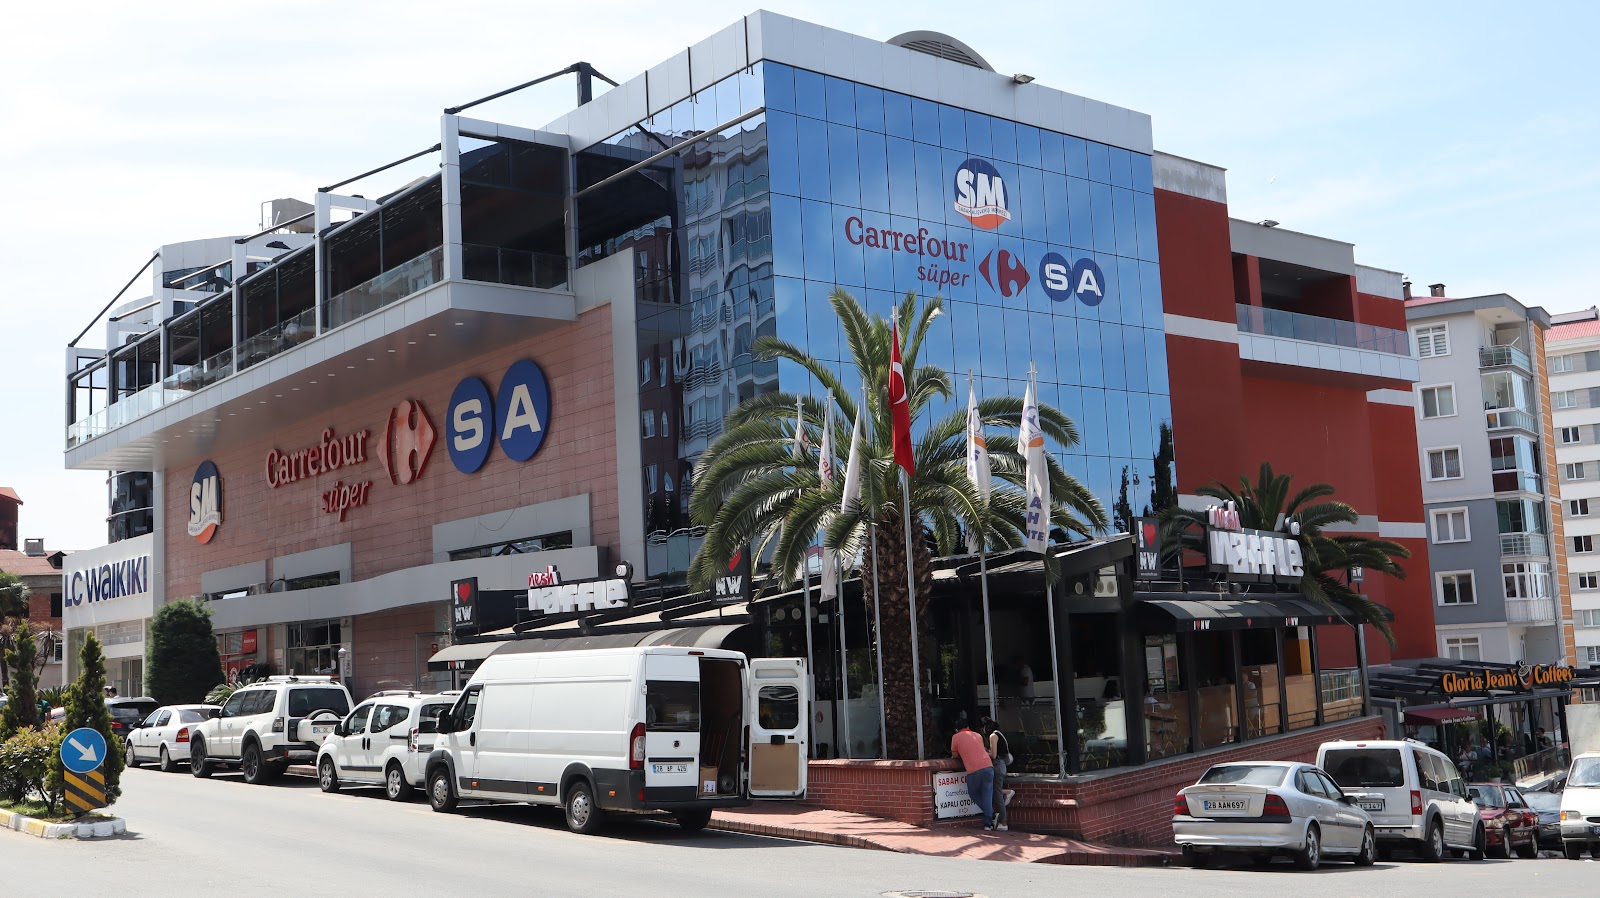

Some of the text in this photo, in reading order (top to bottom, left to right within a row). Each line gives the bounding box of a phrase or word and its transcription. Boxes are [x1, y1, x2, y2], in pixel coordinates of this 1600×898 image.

[957, 168, 1006, 209] SM
[845, 216, 969, 263] Carrefour
[917, 263, 970, 291] süper
[265, 427, 371, 489] Carrefour
[190, 475, 217, 524] SM
[321, 479, 373, 522] süper
[1137, 521, 1144, 548] I
[1139, 552, 1158, 571] NW
[65, 571, 83, 608] LC
[454, 583, 459, 605] I
[715, 575, 743, 596] NW
[455, 605, 473, 622] NW
[1442, 664, 1573, 693] Gloria Jean's Coffees
[938, 777, 959, 786] SABAH
[945, 789, 968, 798] Carrefou
[940, 799, 976, 810] KAPALI OTOP
[1208, 801, 1217, 809] 28
